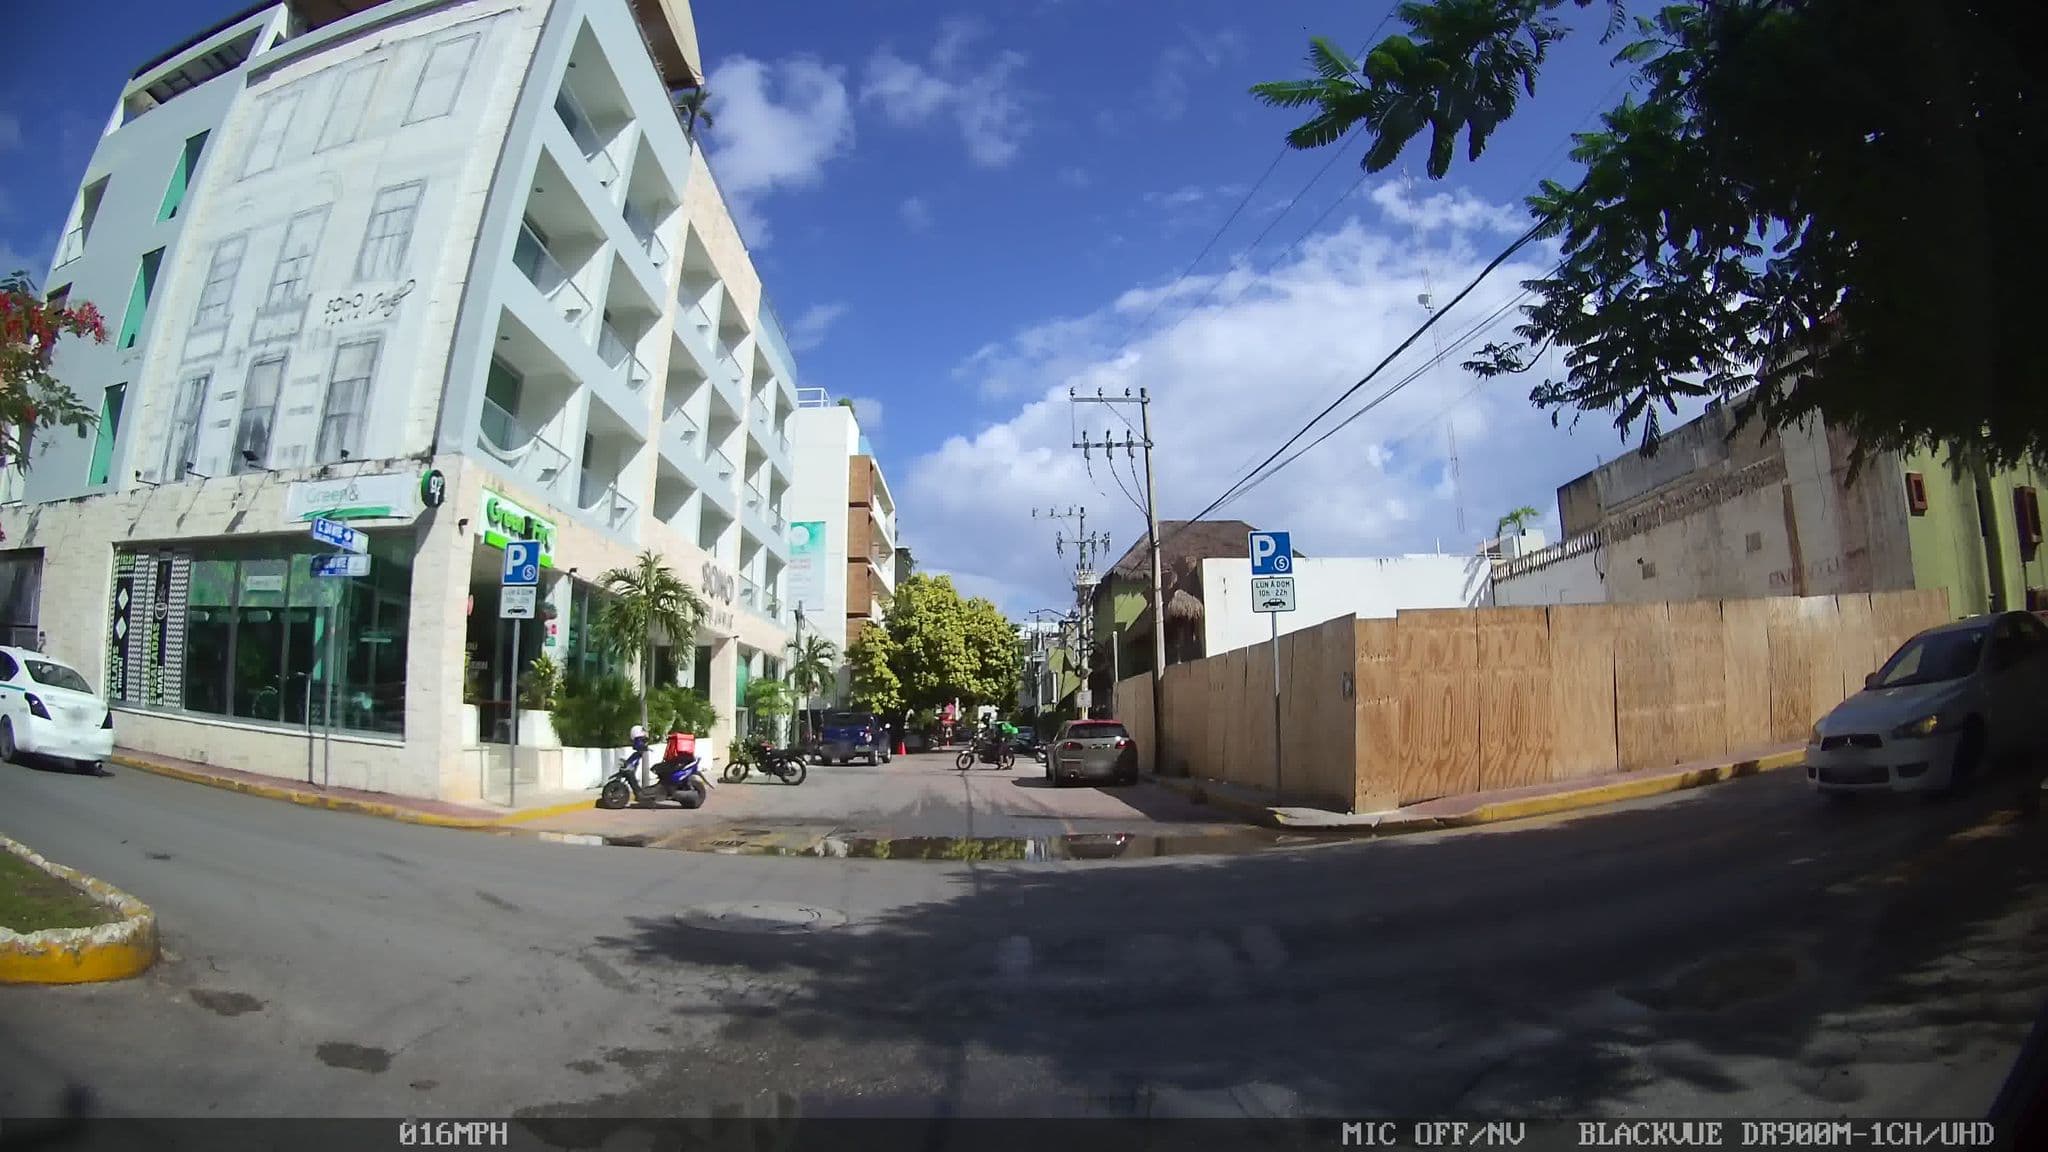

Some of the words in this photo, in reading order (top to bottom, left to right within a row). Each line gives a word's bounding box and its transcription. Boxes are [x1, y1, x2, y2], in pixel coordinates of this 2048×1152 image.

[506, 544, 527, 575] P
[1252, 535, 1276, 567] P
[1276, 580, 1290, 588] DOM
[150, 623, 160, 705] ENSALADAS
